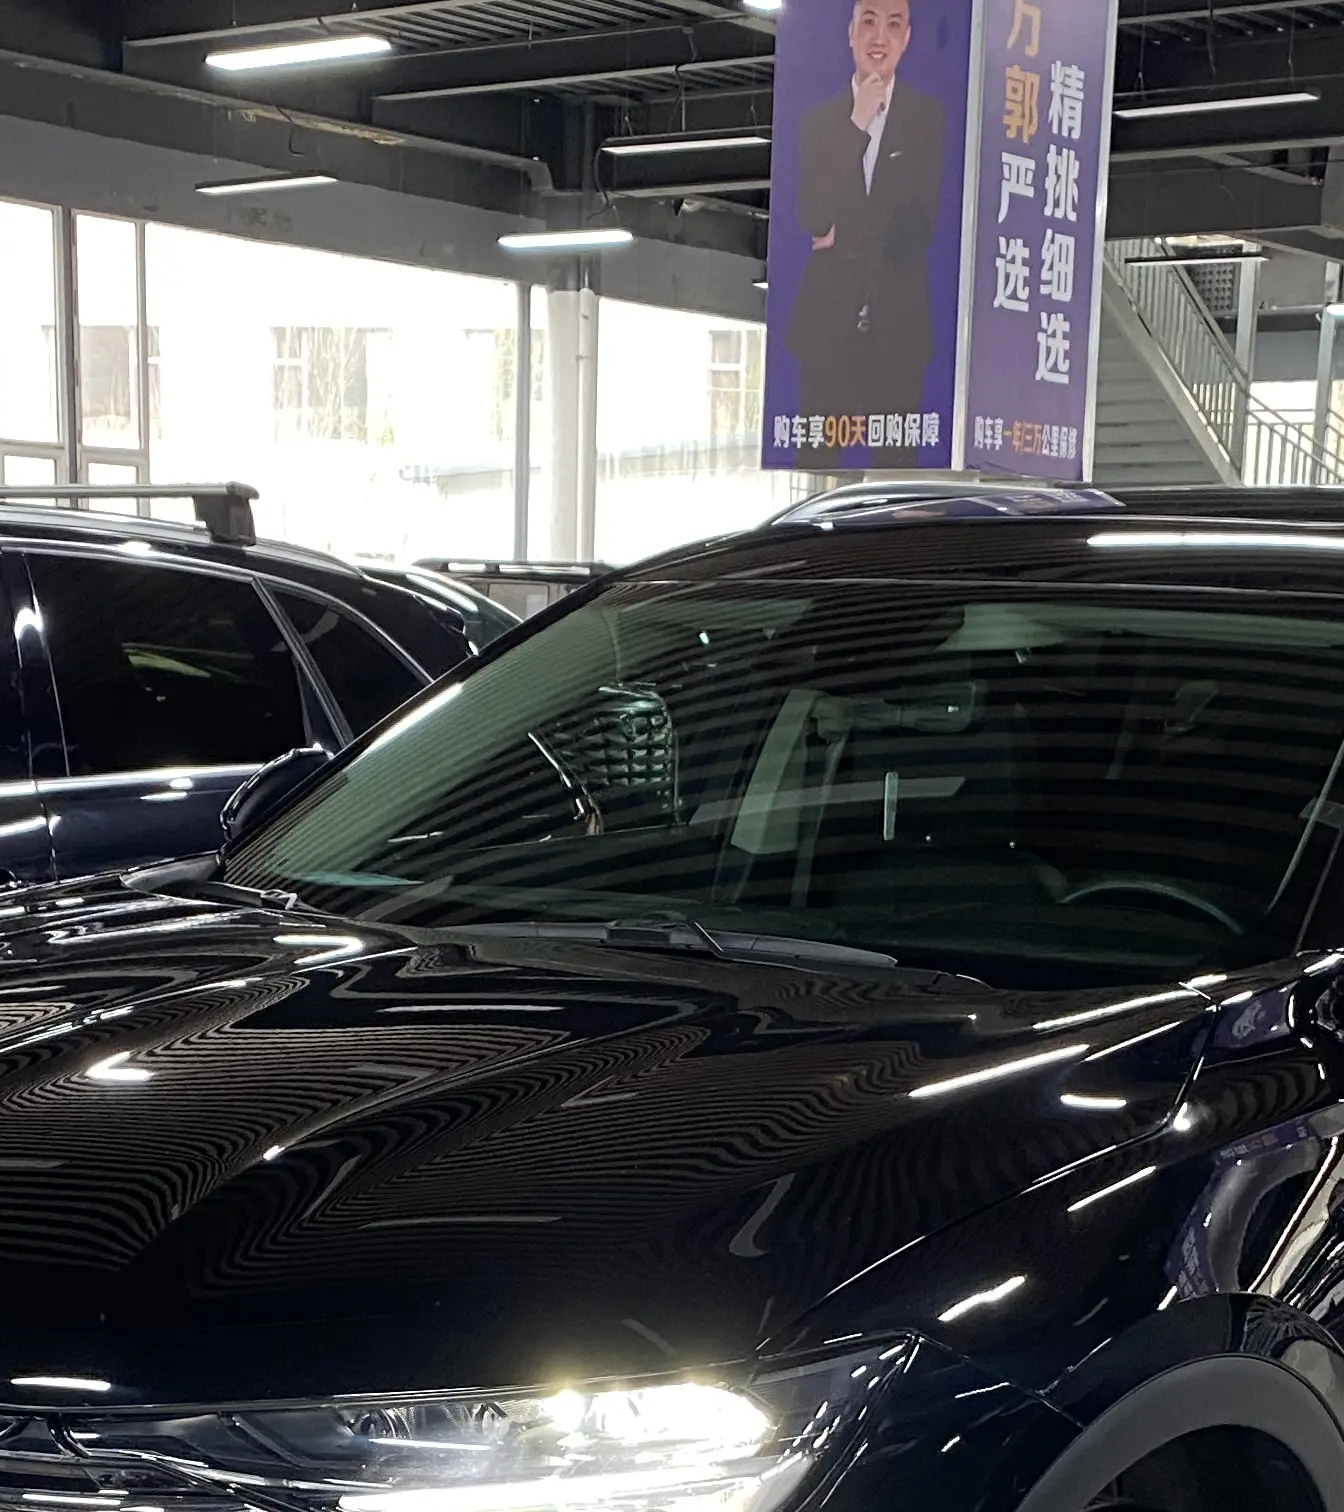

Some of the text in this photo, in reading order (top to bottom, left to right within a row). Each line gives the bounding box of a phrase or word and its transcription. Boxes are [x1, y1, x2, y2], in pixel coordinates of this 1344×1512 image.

[1035, 60, 1085, 385] 精挑细选
[773, 412, 940, 448] 购车享90天回购保障
